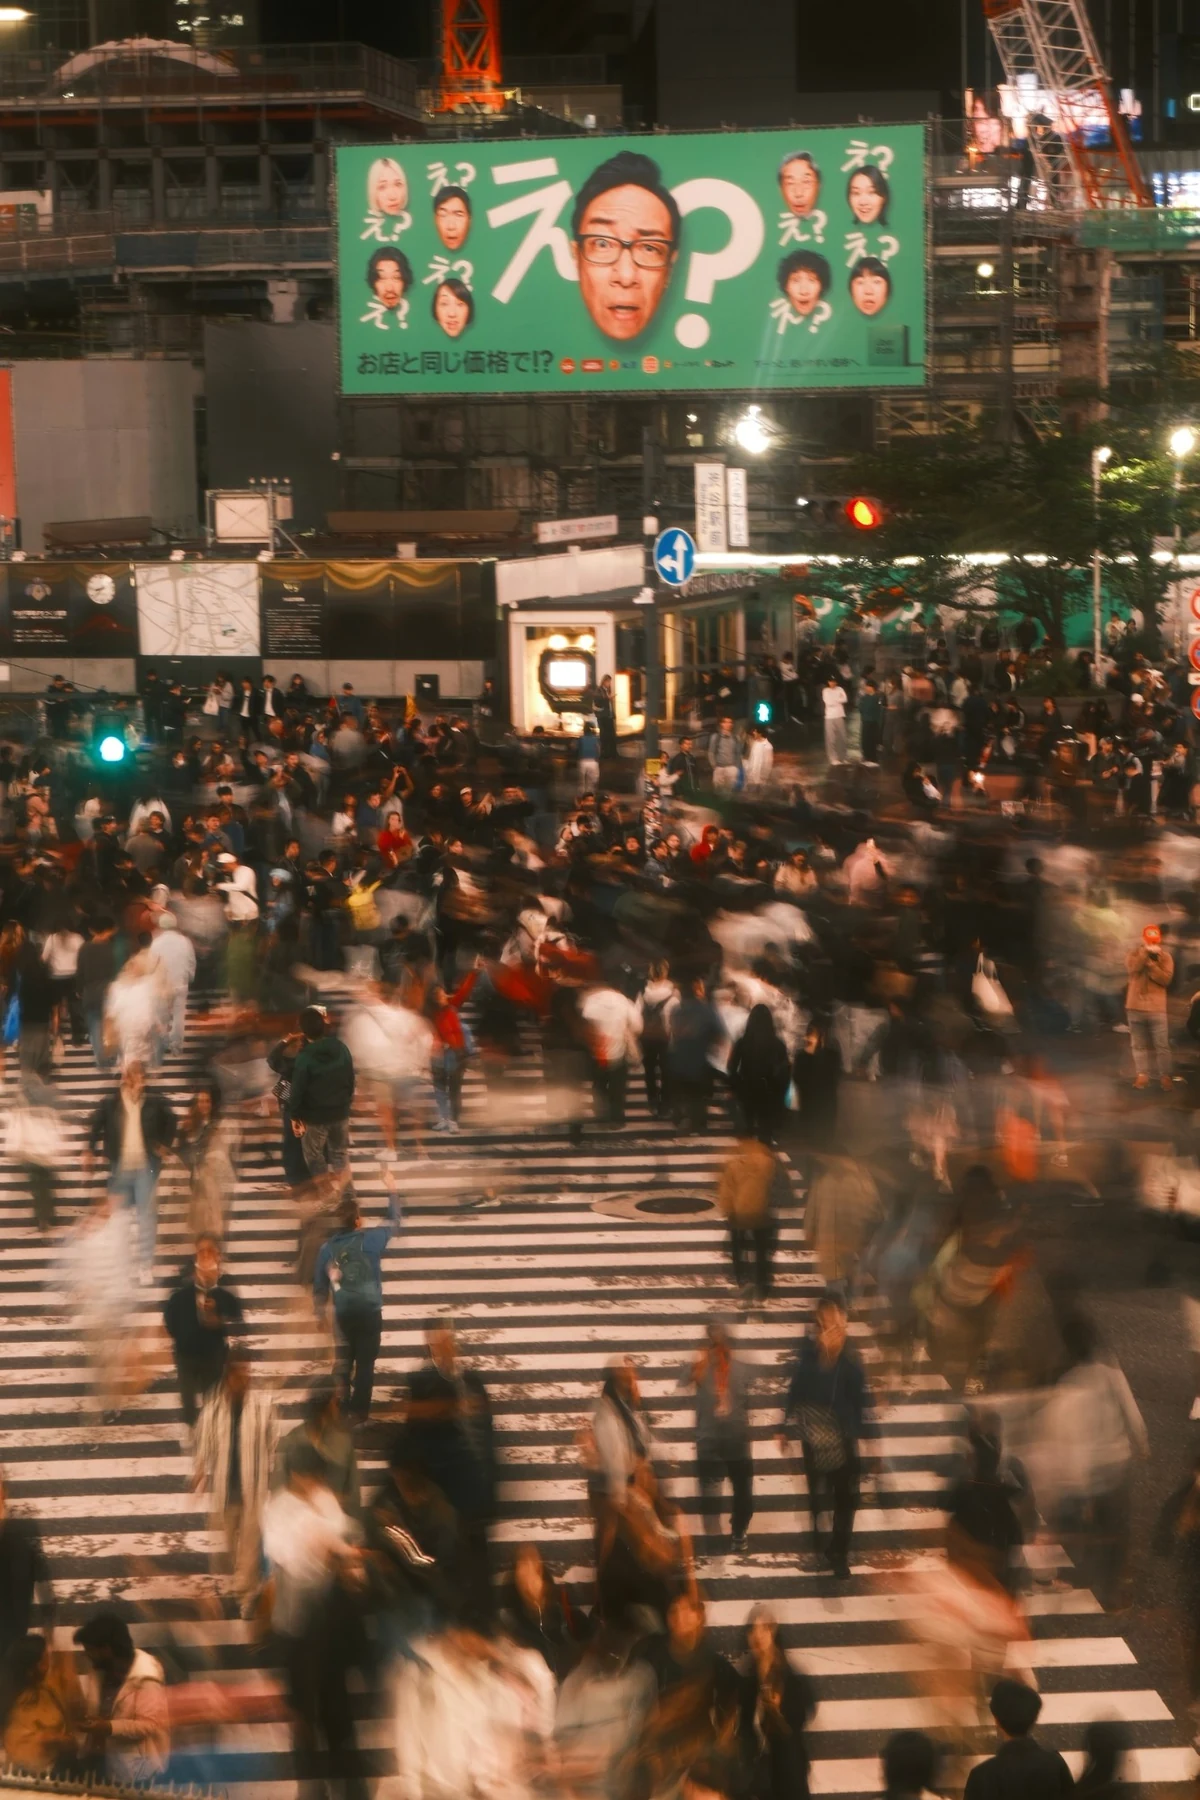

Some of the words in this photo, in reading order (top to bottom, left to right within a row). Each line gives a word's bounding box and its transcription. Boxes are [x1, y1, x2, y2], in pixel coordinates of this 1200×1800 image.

[841, 140, 894, 178] え?
[427, 161, 477, 197] え?
[360, 209, 413, 241] え?
[777, 210, 828, 247] え?
[359, 296, 410, 330] え?
[769, 298, 832, 335] え?
[357, 348, 554, 376] お店と同じ価格で!?
